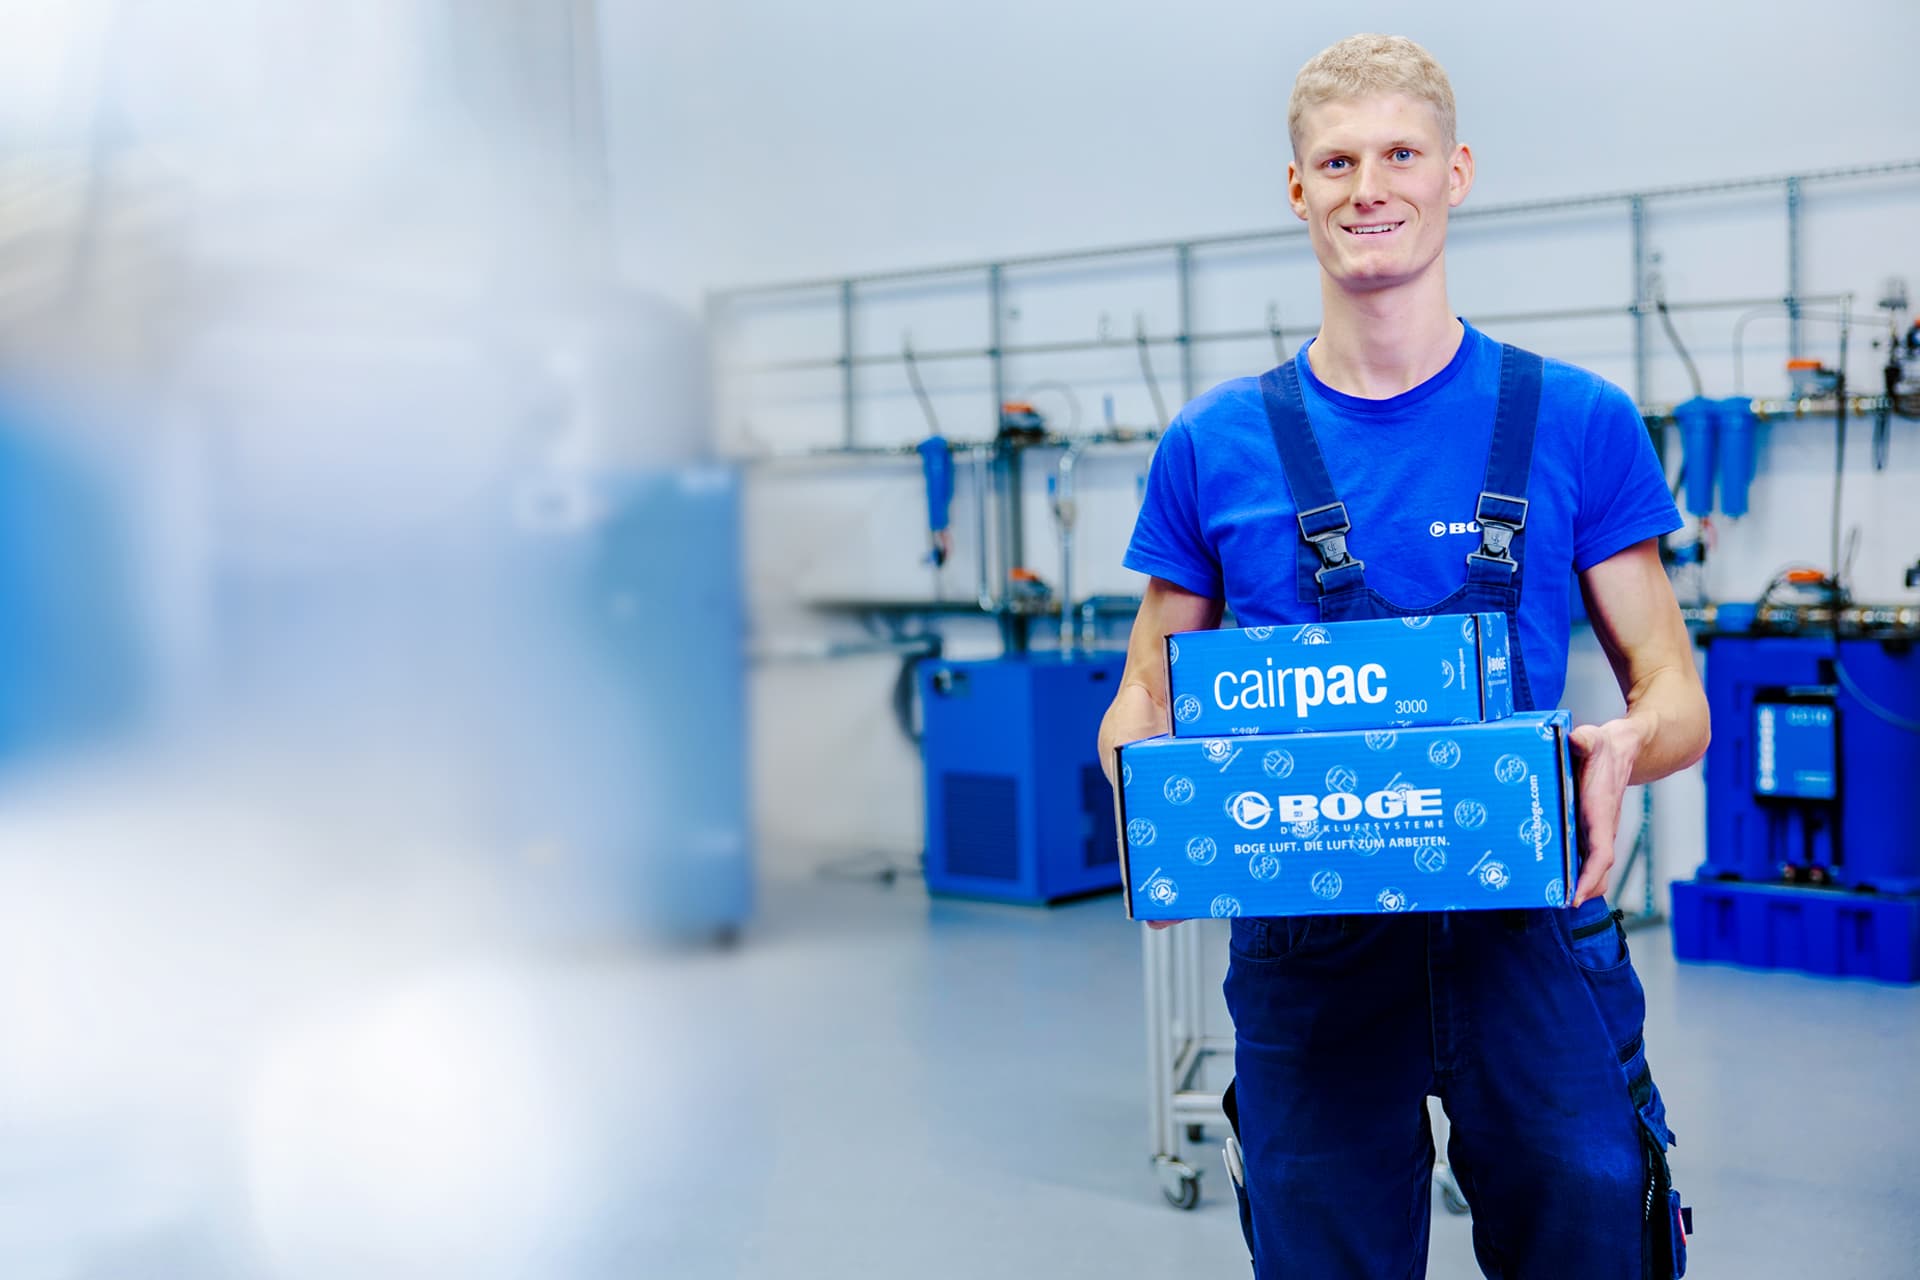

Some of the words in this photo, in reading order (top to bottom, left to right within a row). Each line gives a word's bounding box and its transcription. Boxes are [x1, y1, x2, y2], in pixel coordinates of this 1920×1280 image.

[1449, 521, 1481, 534] BO
[1214, 657, 1388, 718] cairpac
[1395, 699, 1428, 714] 3000
[1278, 788, 1443, 822] BOGE
[1530, 774, 1544, 862] www.boge.com
[1234, 842, 1266, 855] BOGE
[1269, 841, 1301, 853] LUFT.
[1304, 840, 1323, 852] DIE
[1326, 838, 1354, 851] LUFT
[1358, 837, 1386, 850] ZUM
[1389, 835, 1451, 849] ARBEITEN.
